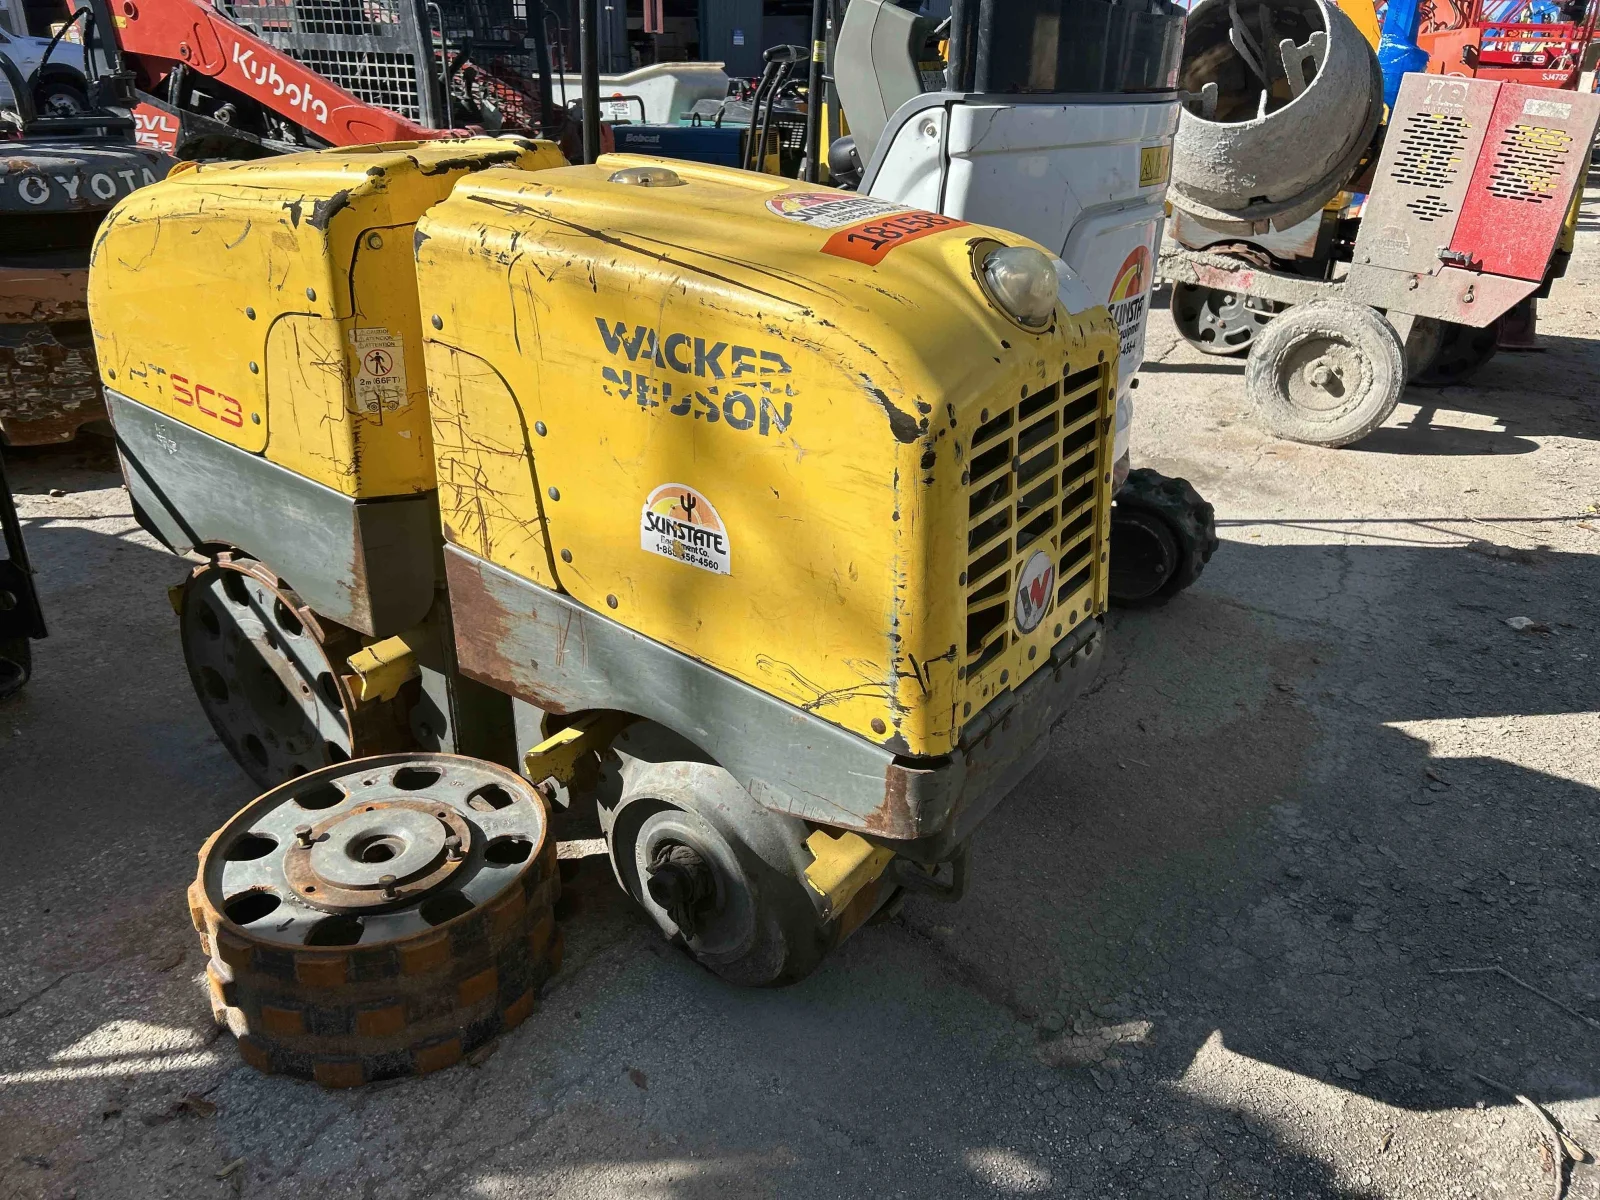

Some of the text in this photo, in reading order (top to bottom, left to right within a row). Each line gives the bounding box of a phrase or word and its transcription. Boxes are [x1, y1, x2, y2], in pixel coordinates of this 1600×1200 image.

[1513, 54, 1545, 63] mec
[232, 41, 328, 124] Kubota
[626, 133, 660, 143] Bobcat
[0, 168, 157, 205] OYOTA
[644, 511, 726, 555] SUNSTATE
